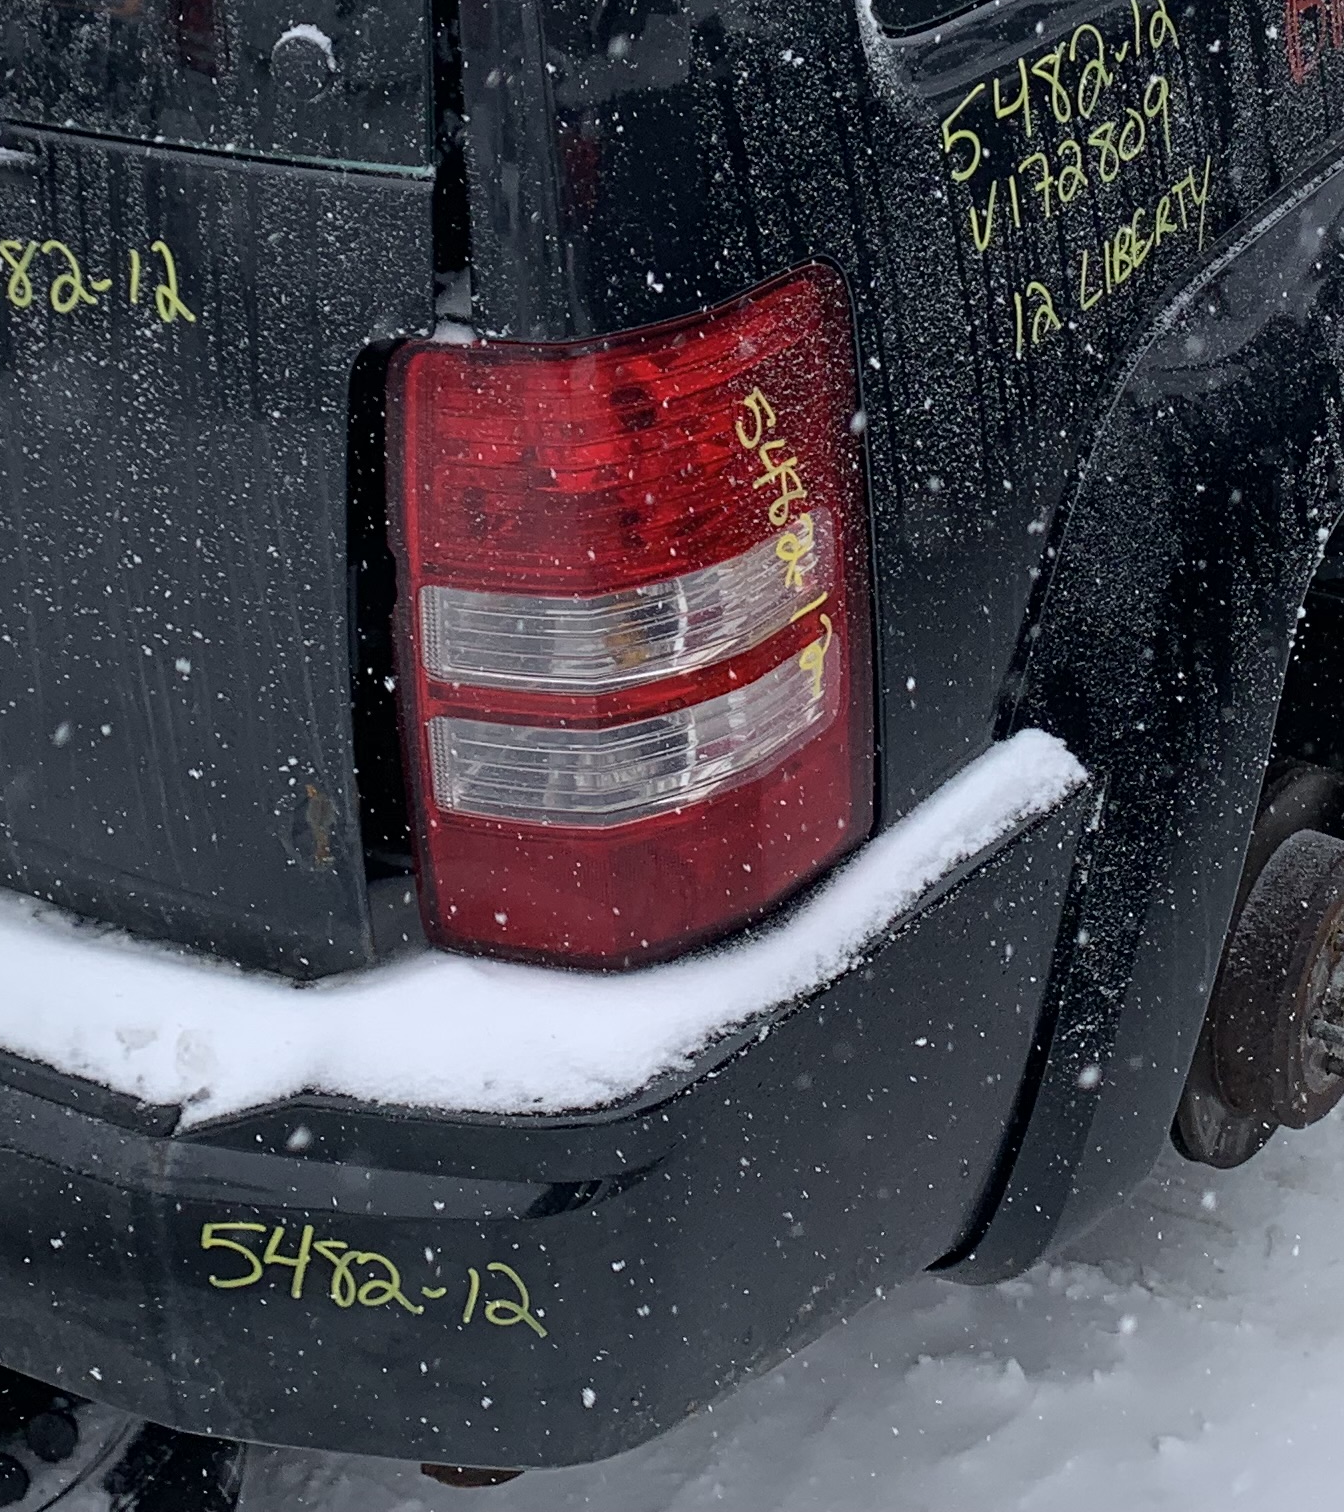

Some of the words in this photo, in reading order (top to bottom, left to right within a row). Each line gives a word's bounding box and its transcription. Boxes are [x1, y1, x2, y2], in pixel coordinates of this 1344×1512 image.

[969, 75, 1172, 252] V172809
[1013, 281, 1062, 361] 12
[1079, 154, 1212, 311] LIBERTY
[200, 1222, 548, 1339] 5482-12
